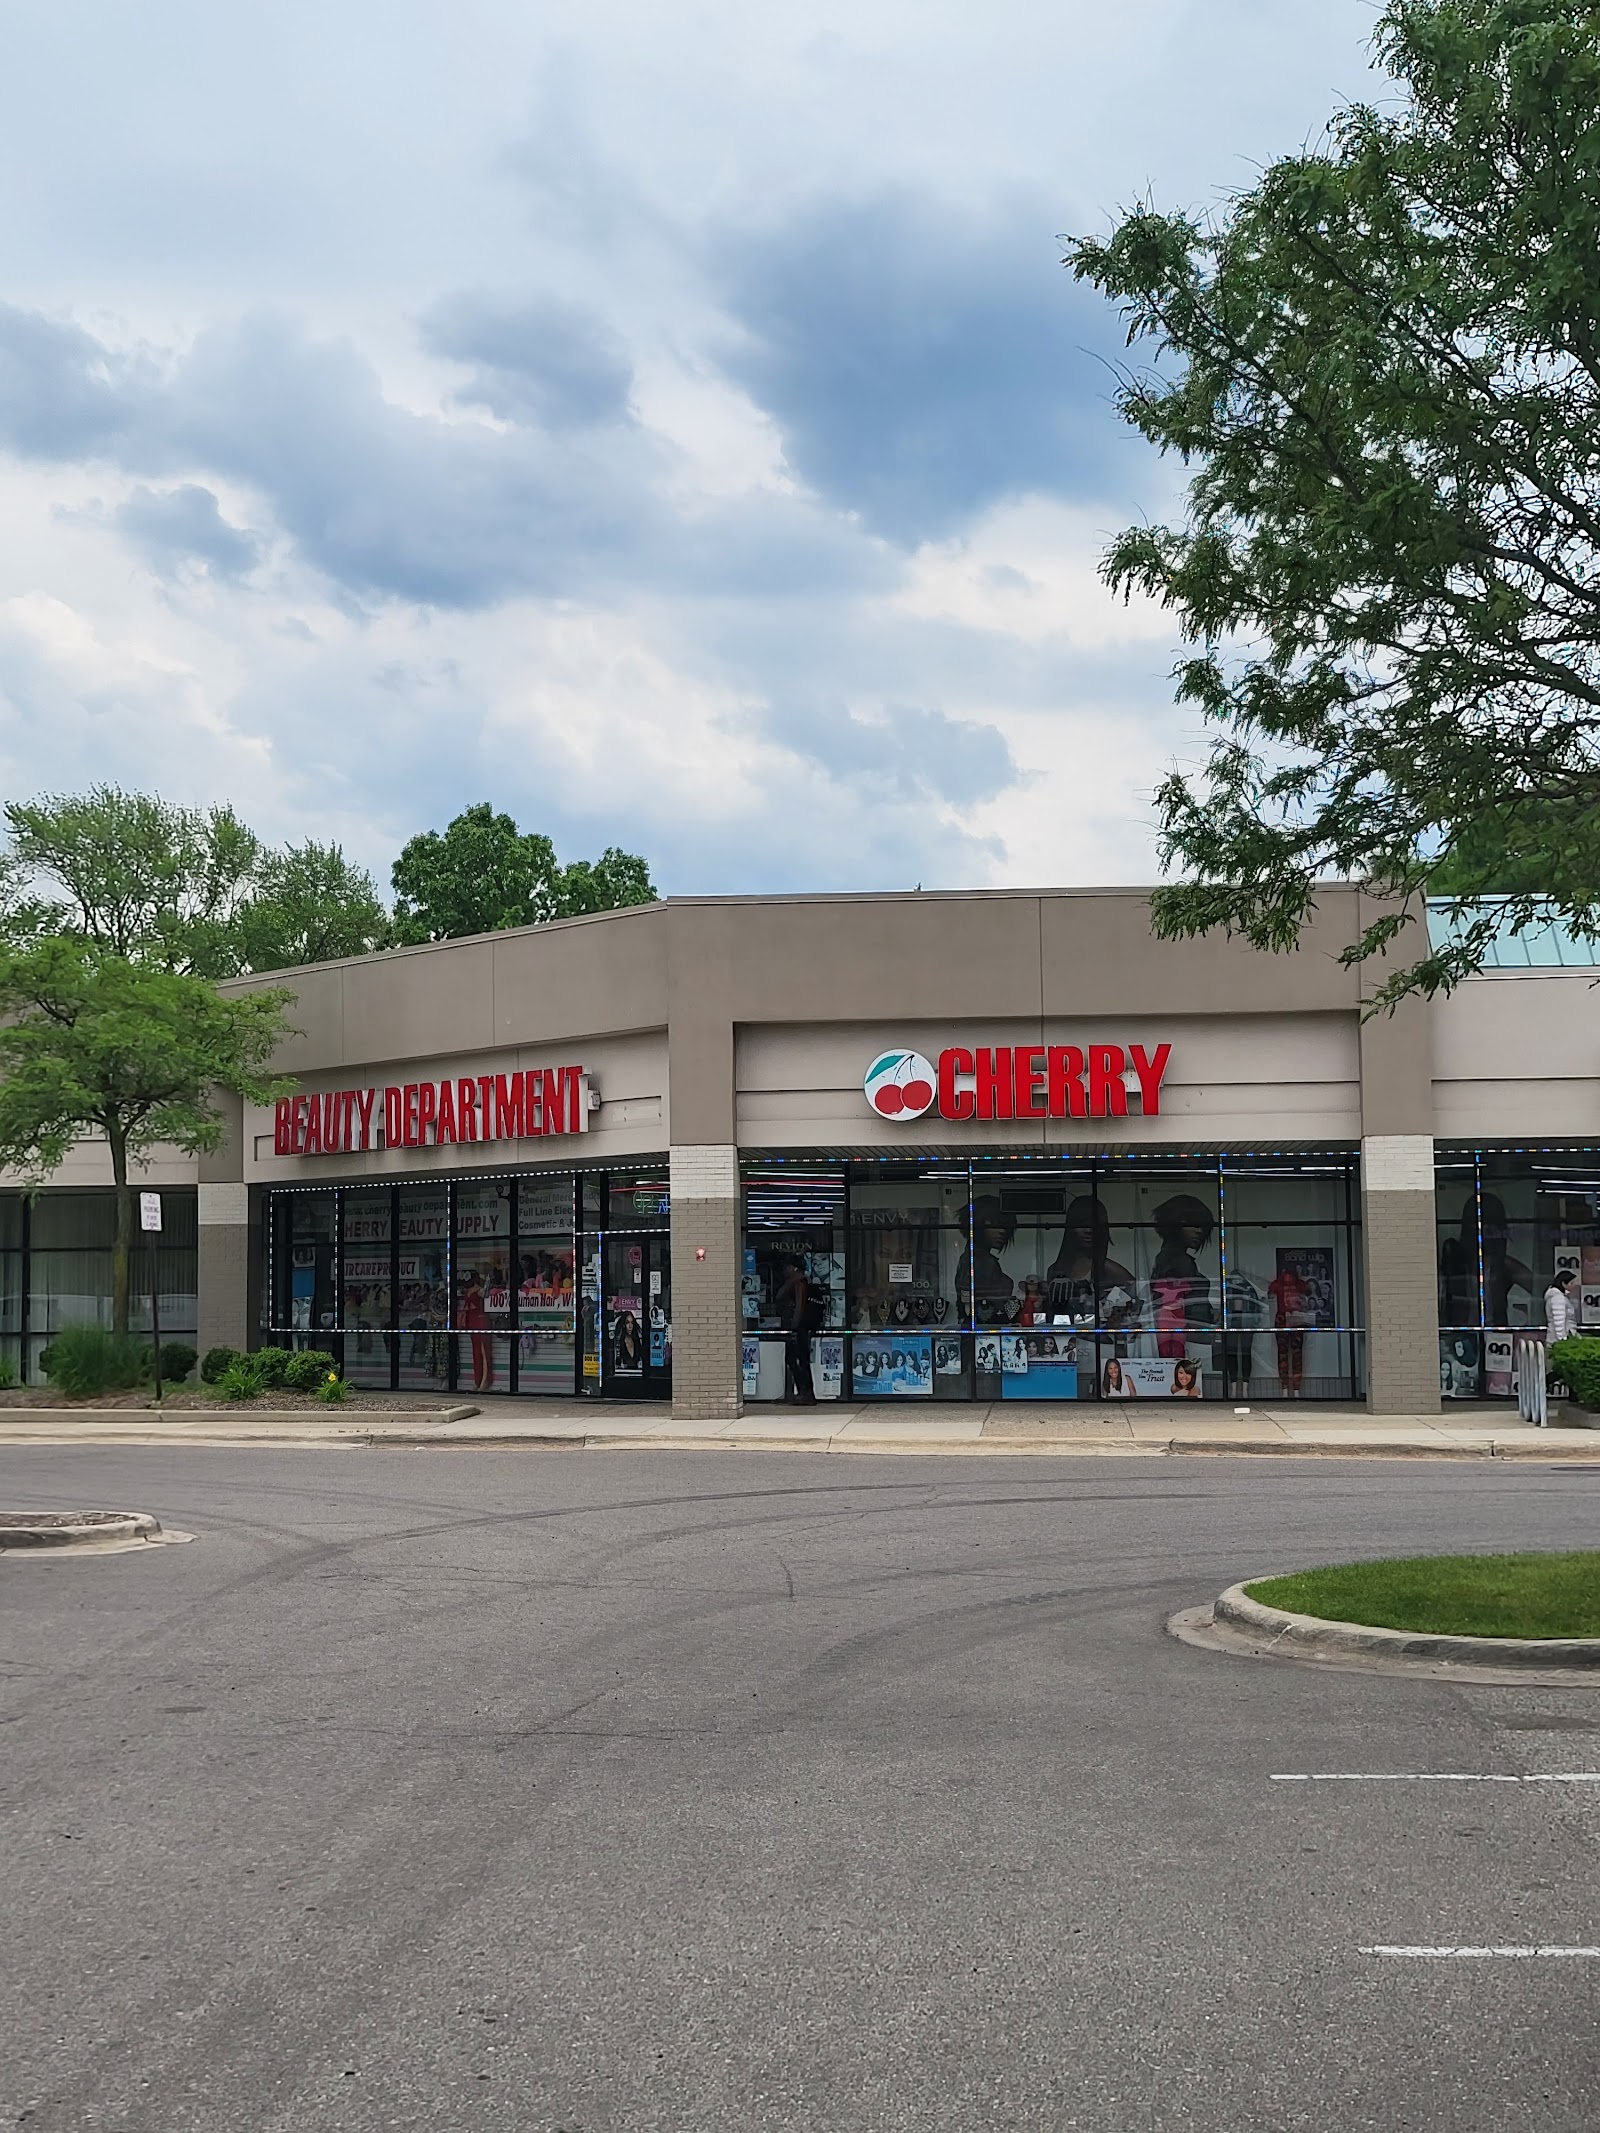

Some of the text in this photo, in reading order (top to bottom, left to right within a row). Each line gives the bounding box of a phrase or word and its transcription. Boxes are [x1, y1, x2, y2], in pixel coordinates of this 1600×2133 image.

[937, 1044, 1172, 1120] CHERRY
[275, 1065, 586, 1155] BEAUTY DEPARTMENT
[518, 1193, 550, 1205] General
[518, 1206, 533, 1217] Full
[535, 1205, 552, 1216] Line
[344, 1214, 499, 1238] HERRY EAUTY UPPLY
[518, 1218, 556, 1230] Cosmetic
[560, 1217, 565, 1228] &
[912, 1281, 930, 1290] 100
[518, 1294, 539, 1307] uman
[1146, 1373, 1165, 1382] Trust
